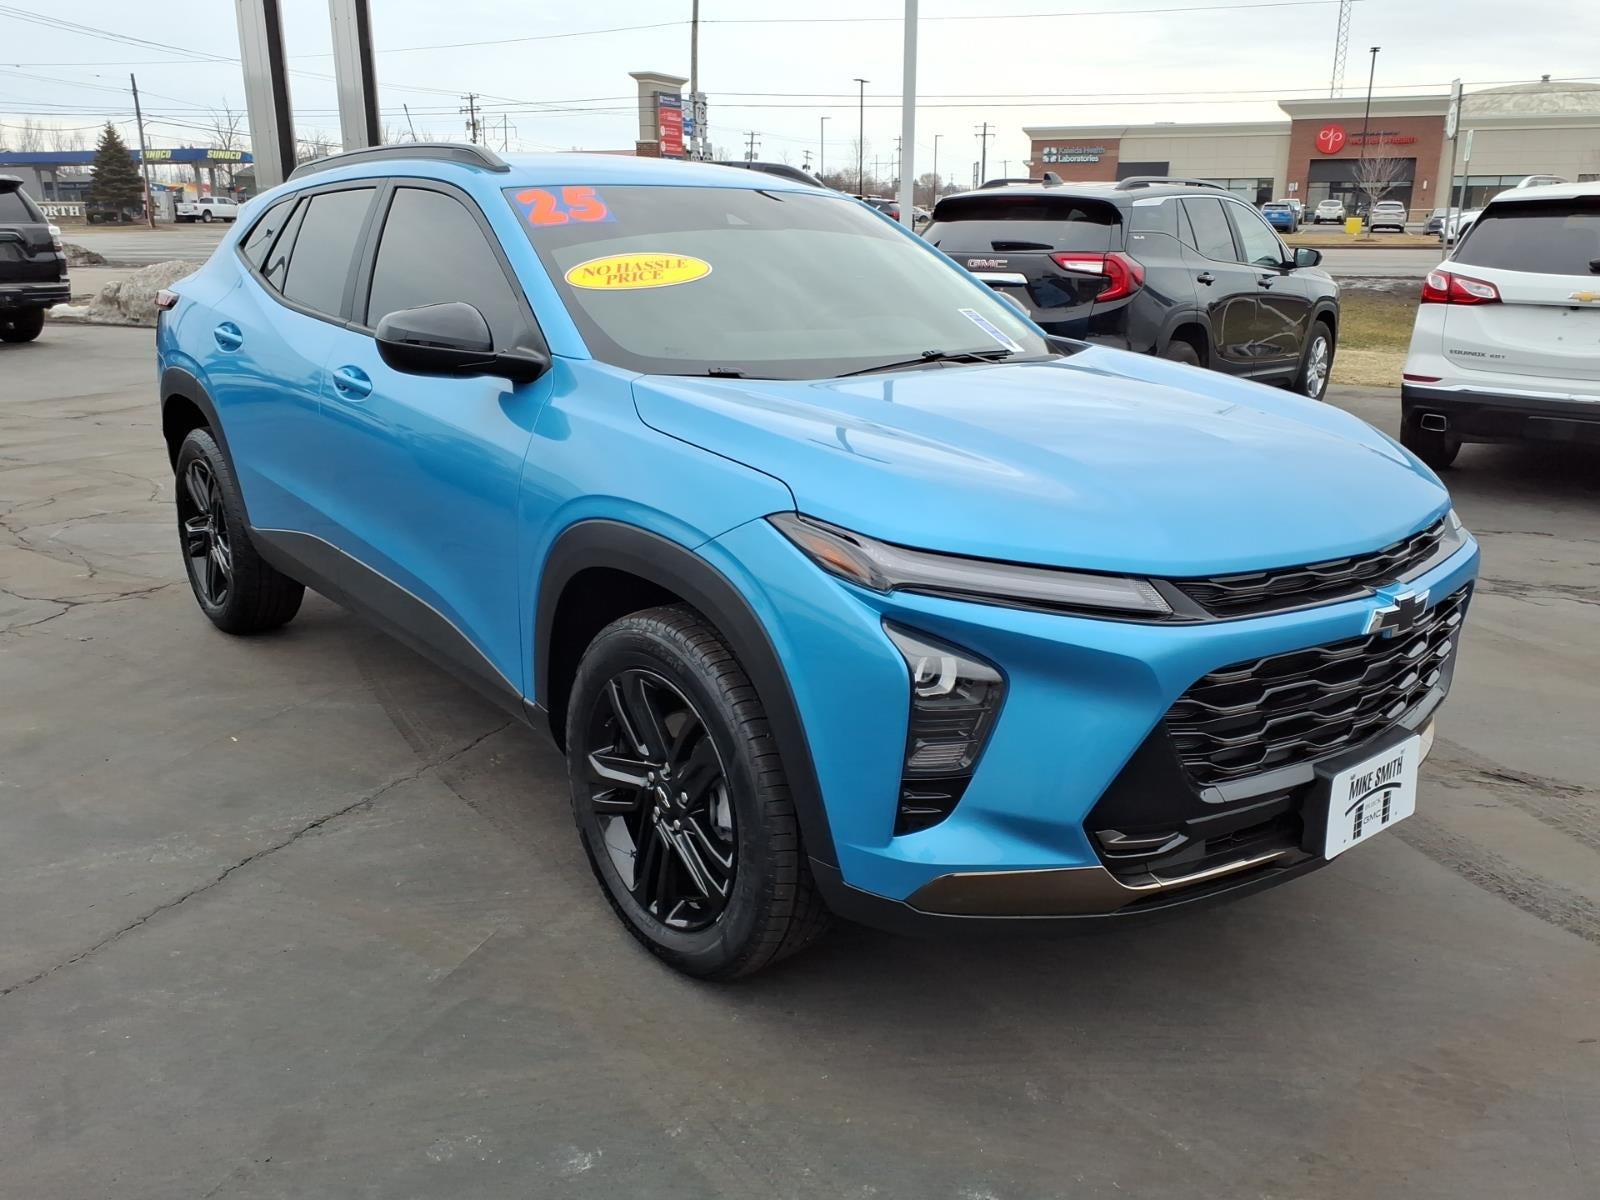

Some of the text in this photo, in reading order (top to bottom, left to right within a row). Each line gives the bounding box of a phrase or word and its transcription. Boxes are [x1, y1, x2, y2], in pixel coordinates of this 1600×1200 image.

[207, 150, 242, 160] SUNOCO
[1083, 146, 1104, 154] Health
[1058, 154, 1099, 162] Laboratories
[516, 186, 607, 225] 25
[582, 258, 688, 279] NO HASSLE
[968, 259, 1008, 268] GMC
[606, 269, 663, 286] PRICE
[1349, 756, 1404, 800] MIKE SMITH
[1363, 809, 1381, 824] GMC
